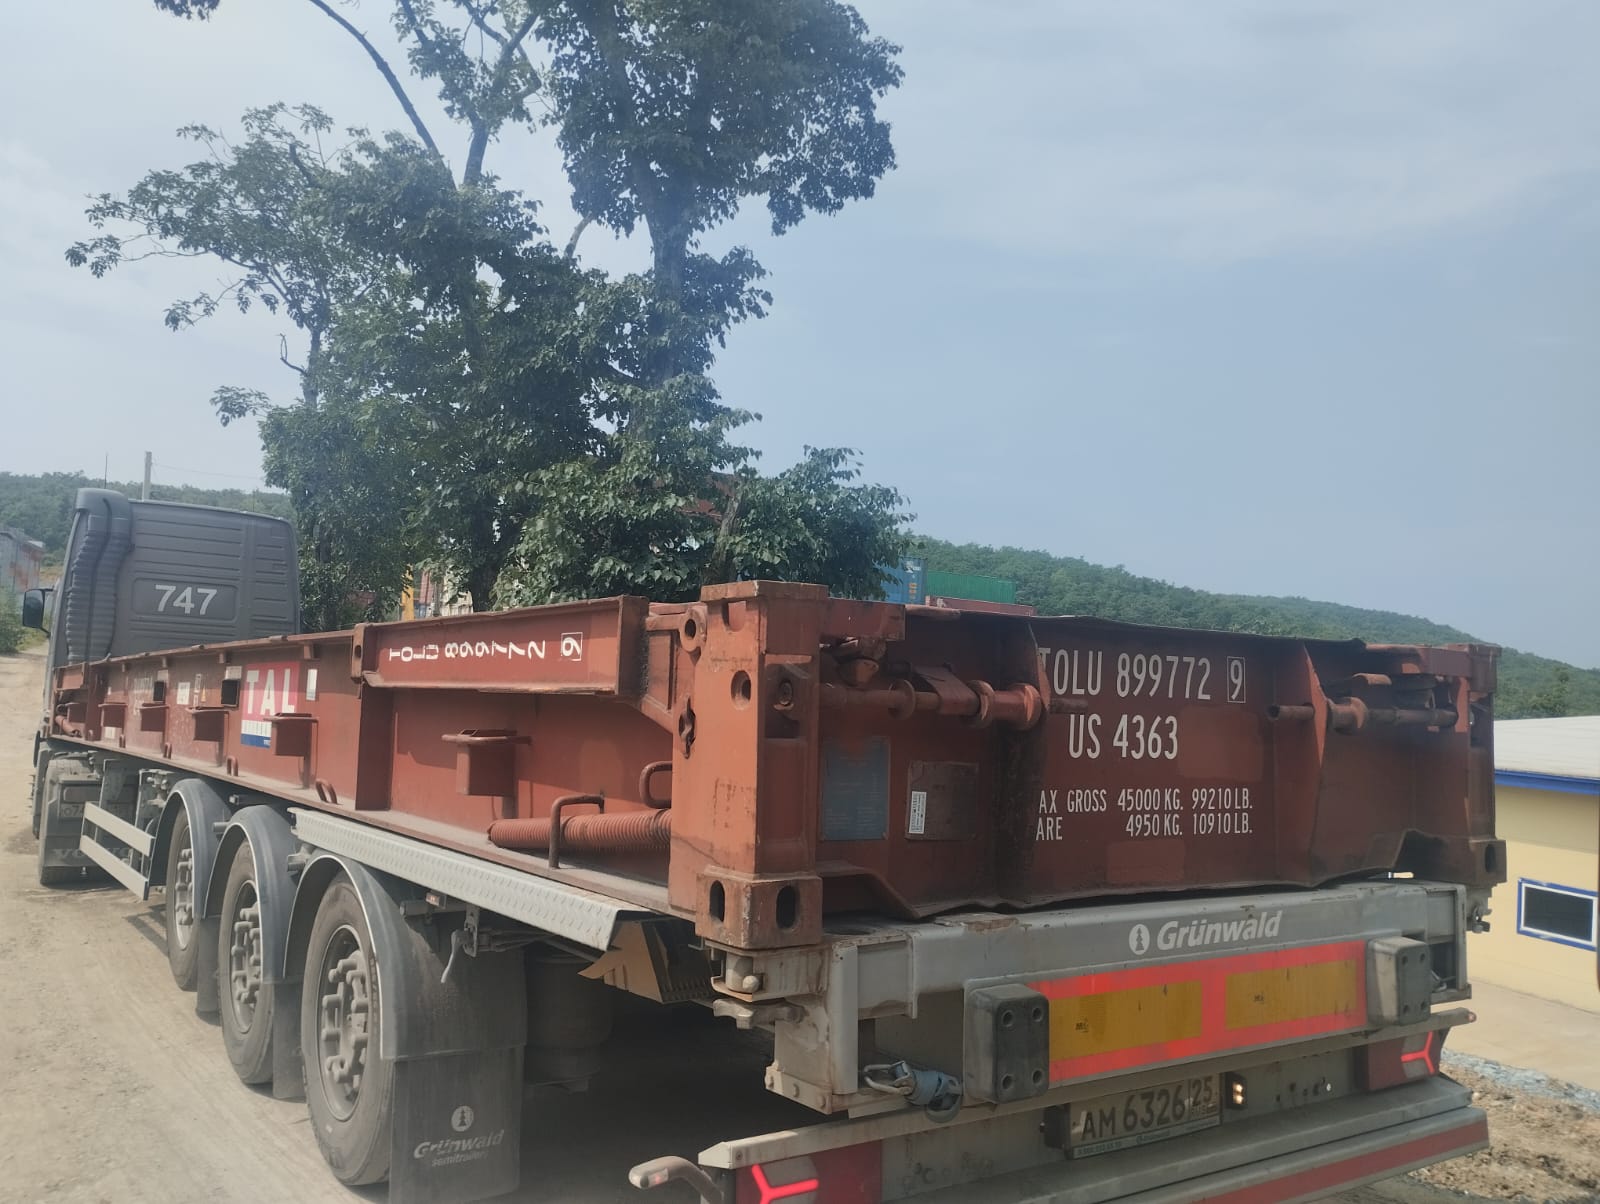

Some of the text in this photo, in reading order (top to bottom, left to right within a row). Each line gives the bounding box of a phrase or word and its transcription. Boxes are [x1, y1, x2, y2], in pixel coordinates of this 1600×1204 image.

[155, 584, 217, 615] 747
[561, 636, 583, 658] 9
[246, 668, 295, 716] TAL
[1116, 653, 1211, 700] 899772
[1229, 659, 1245, 702] 9
[1068, 713, 1178, 760] US 4363
[1039, 787, 1253, 814] AX GROSS 45000 KG. 99210 LB.
[1036, 813, 1253, 841] ARE 4950 KG. 10910 LB.
[1157, 912, 1281, 950] Grünwald
[1191, 1076, 1213, 1106] 25
[413, 1129, 505, 1159] Grünwald
